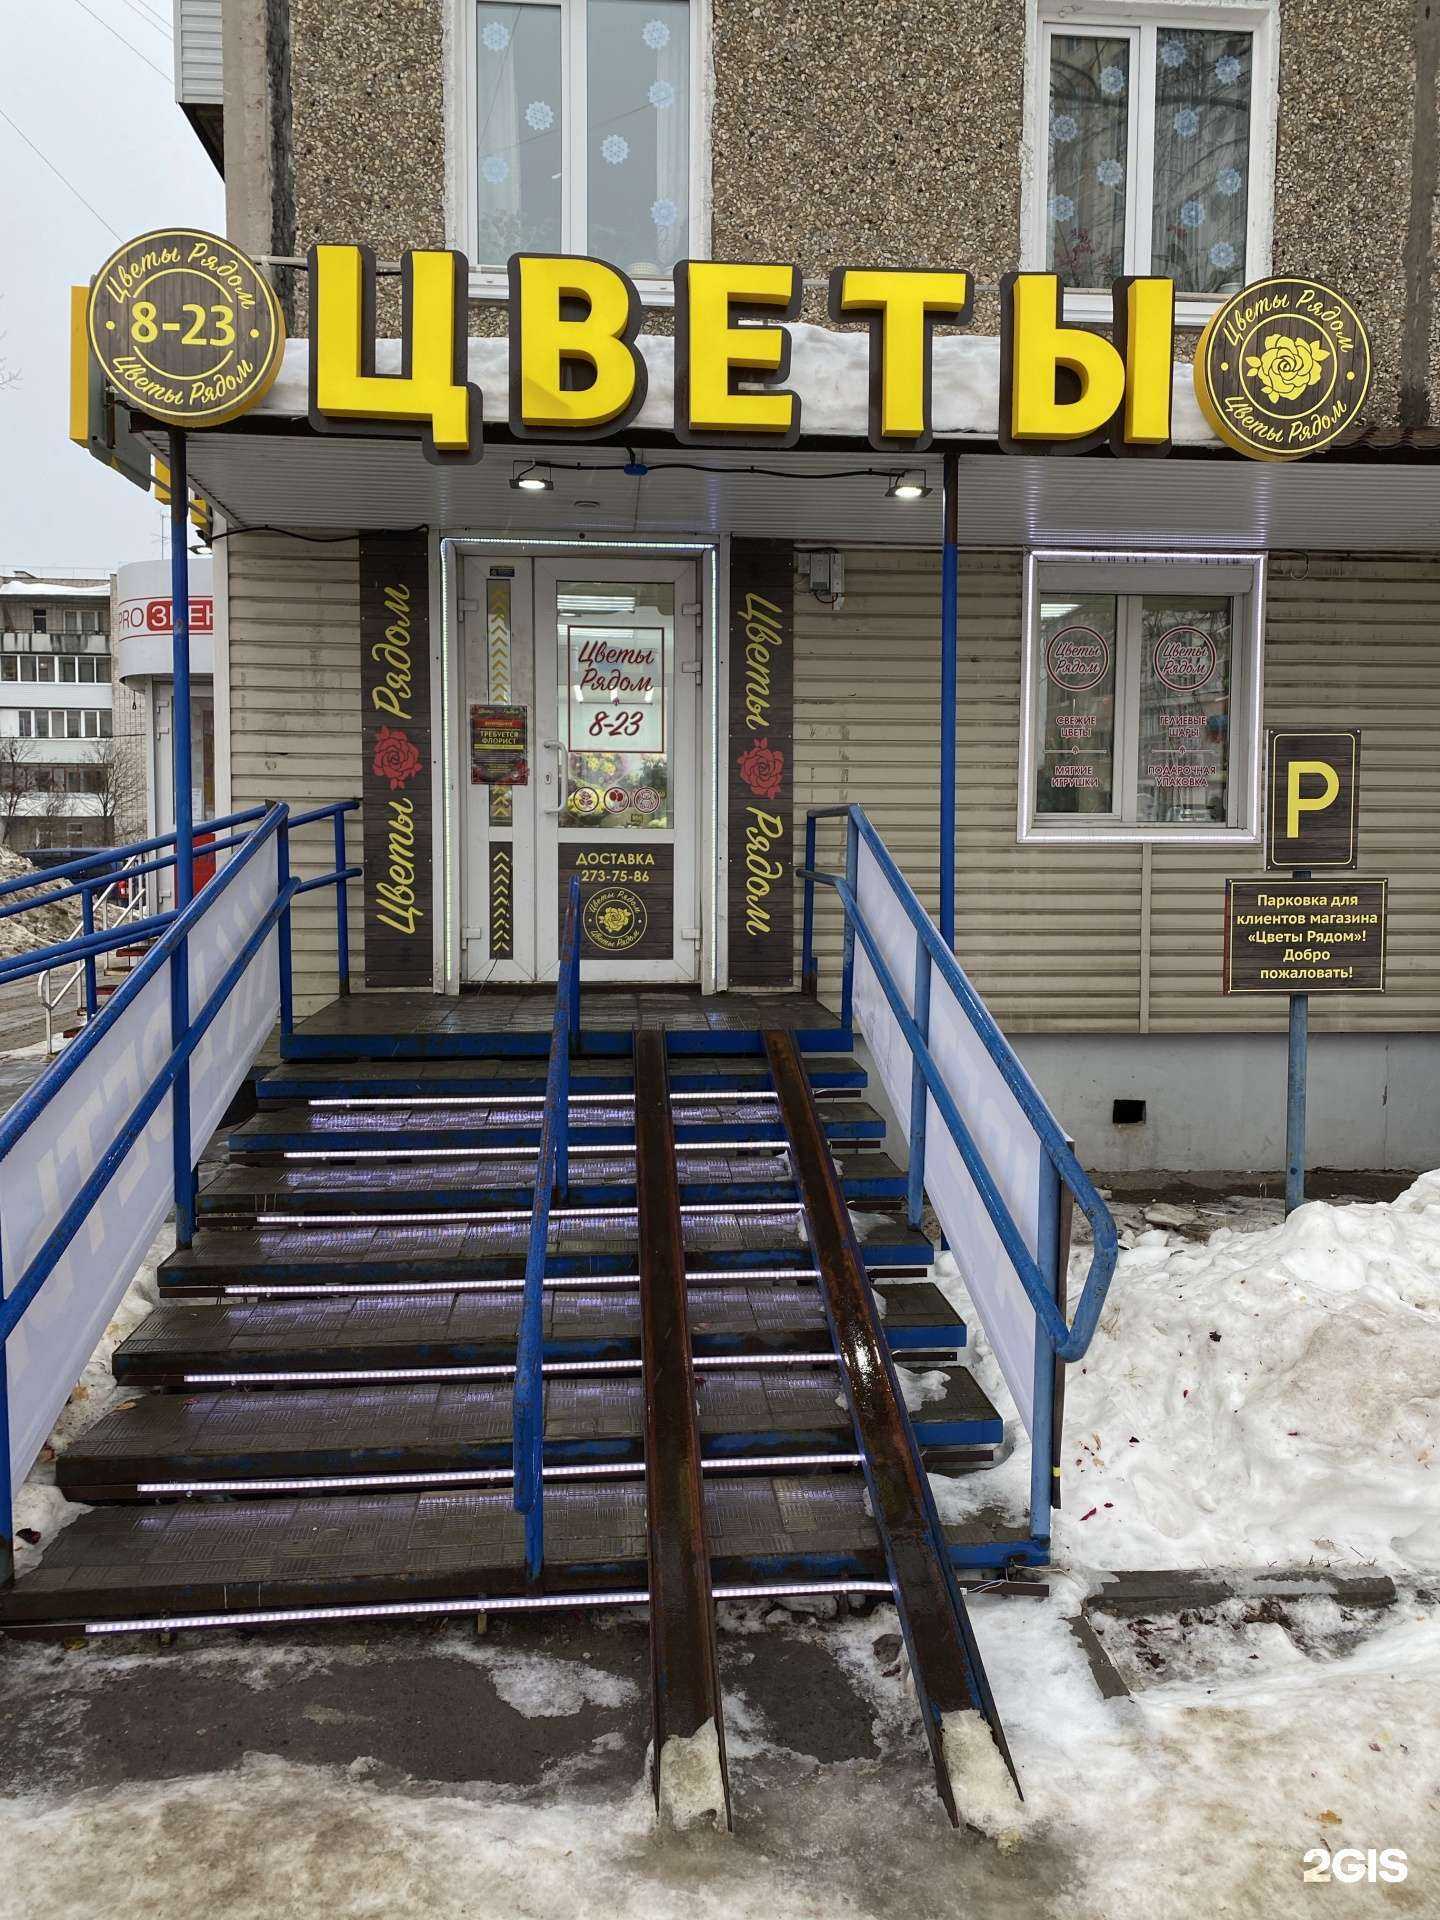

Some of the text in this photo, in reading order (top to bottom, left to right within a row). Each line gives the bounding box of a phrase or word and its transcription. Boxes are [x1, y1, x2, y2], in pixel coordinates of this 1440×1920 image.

[106, 242, 255, 310] Цветы Рядом
[131, 301, 236, 347] 8-23
[1223, 289, 1354, 353] Цветы Рядом
[314, 243, 1175, 453] ЦВЕТЫ
[112, 356, 253, 405] Цветы Рядом
[1224, 396, 1347, 444] Цветы Рядом
[578, 640, 655, 668] Цветы
[1055, 641, 1101, 660] Цветы
[1162, 641, 1208, 660] Цветы
[1055, 659, 1100, 675] Рядом
[1162, 659, 1206, 675] Рядом
[580, 668, 654, 692] Рядом
[588, 711, 645, 737] 8-23
[1056, 715, 1096, 726] СВЕЖИЕ
[1160, 715, 1207, 726] ГЕЛИЕВЫЕ
[1061, 727, 1092, 738] ЦВЕТЫ
[1169, 727, 1200, 738] ШАРЫ
[371, 583, 424, 935] Цветы Рядом
[736, 591, 784, 937] Цветы Рядом
[1055, 765, 1092, 776] МЯГКИЕ
[1148, 765, 1216, 777] ПОДАРОЧНАЯ
[1051, 777, 1099, 788] ИГРУШКИ
[1156, 776, 1208, 788] УПАКОВКА
[1286, 760, 1340, 839] P
[576, 852, 655, 866] ДОСТАВКА
[581, 869, 650, 882] 273-75-86
[1257, 894, 1359, 909] Парковка для
[1236, 912, 1378, 926] клиентов магазина
[1248, 929, 1367, 945] «Цветы Рядом»!
[1282, 948, 1331, 963] Добро
[1260, 965, 1353, 980] пожаловать!
